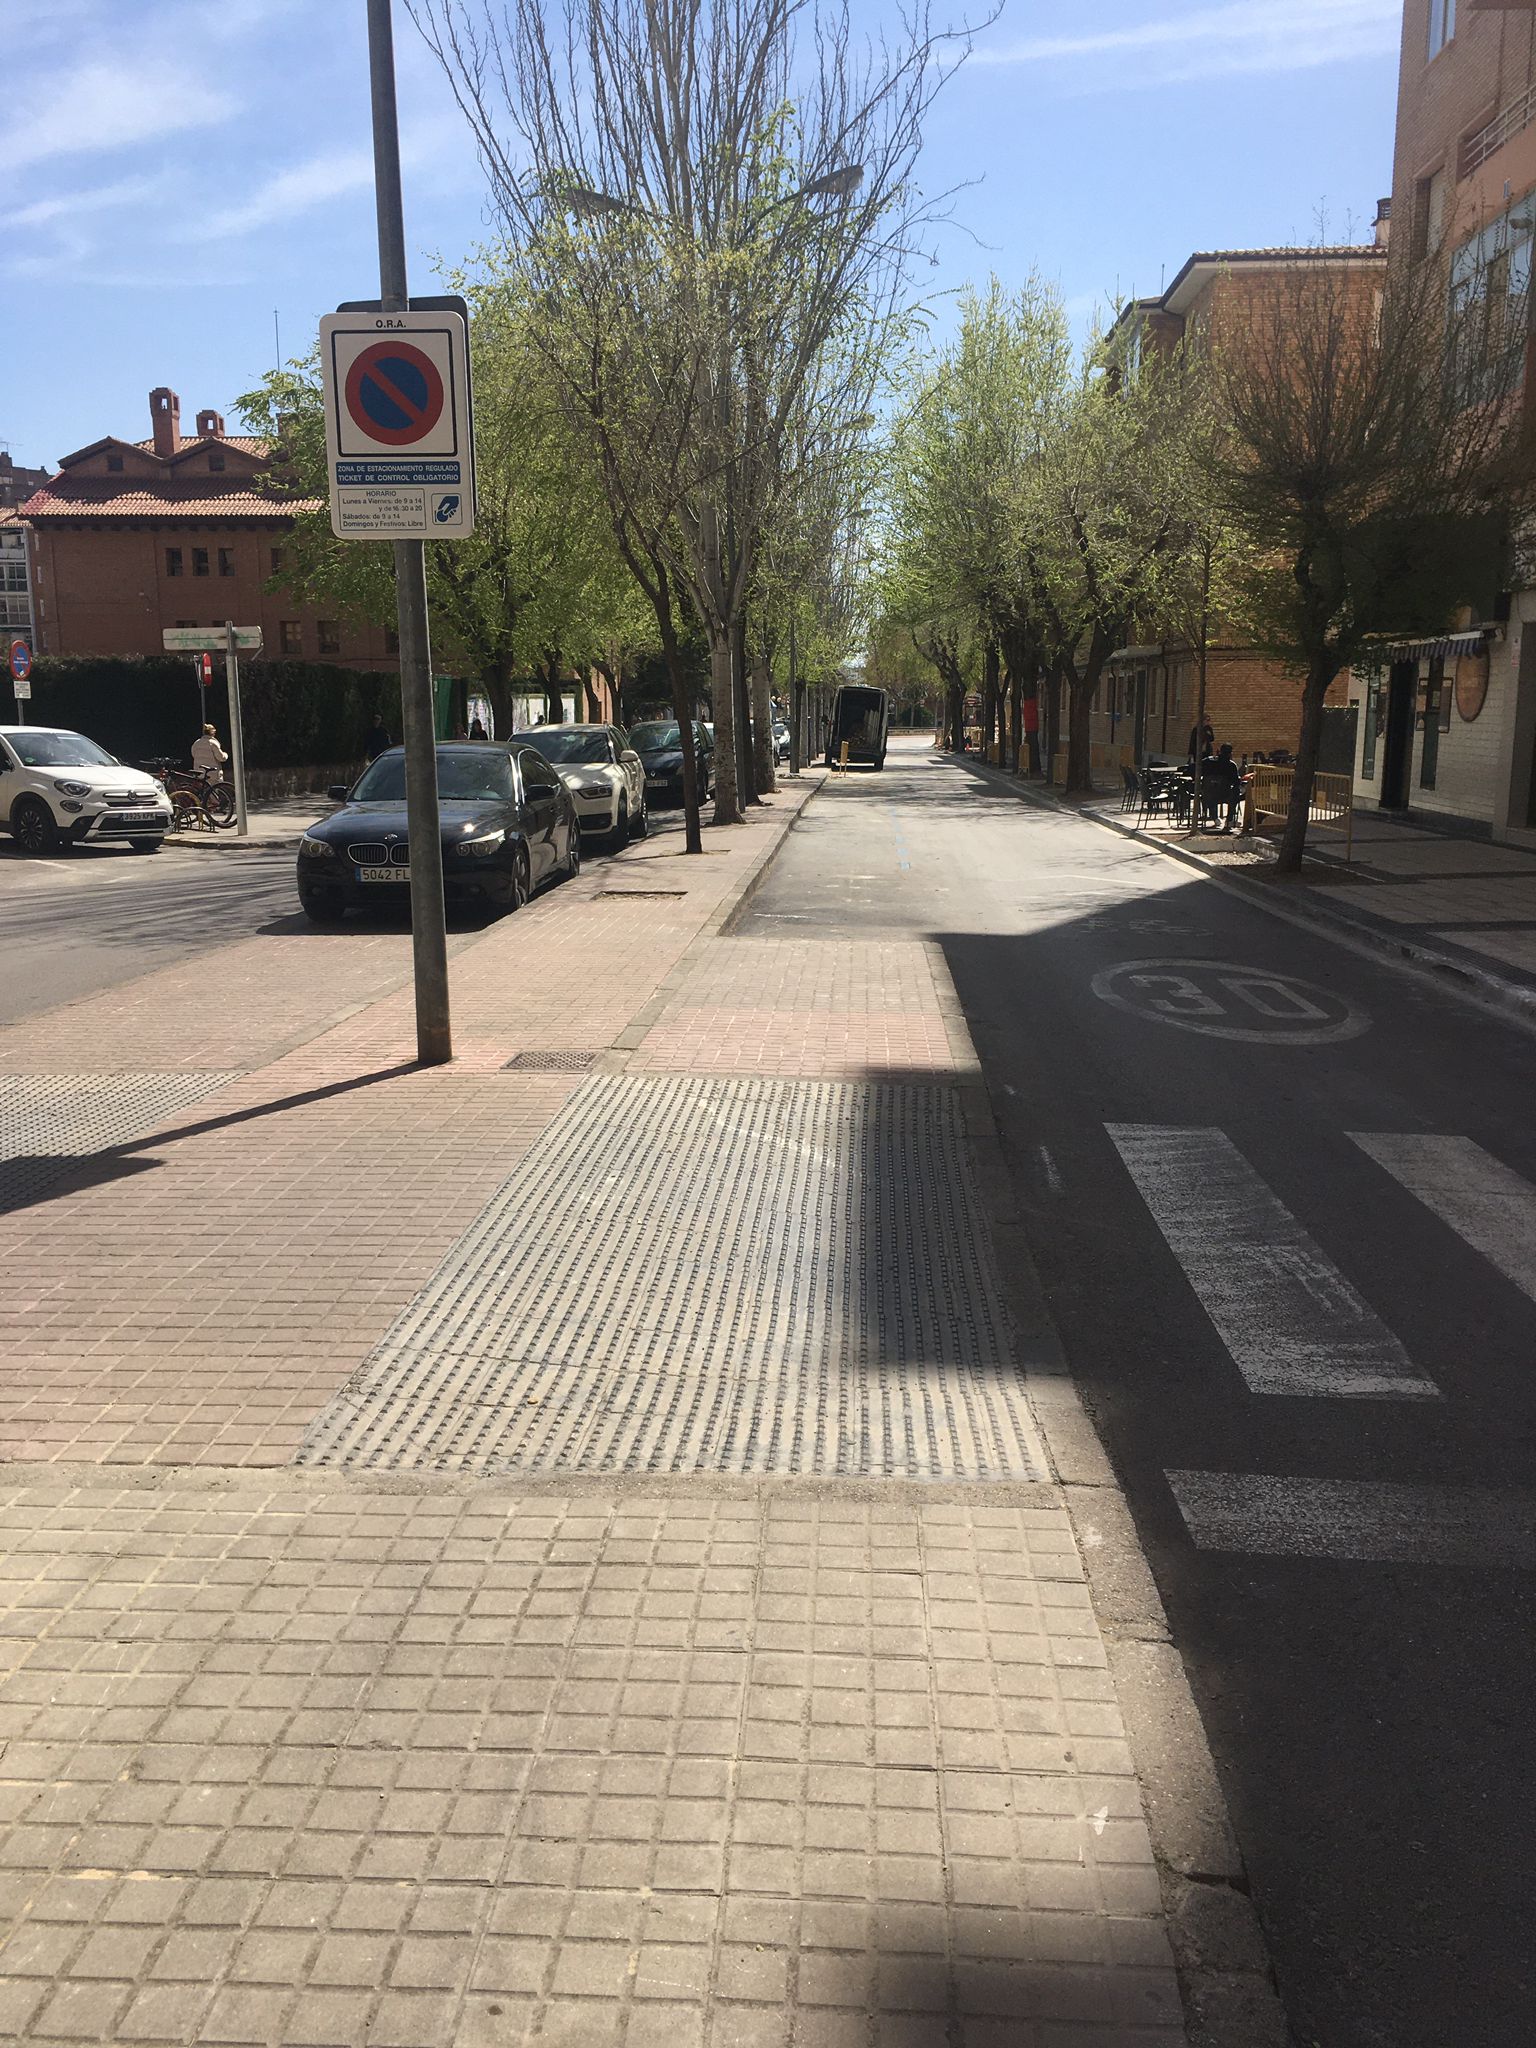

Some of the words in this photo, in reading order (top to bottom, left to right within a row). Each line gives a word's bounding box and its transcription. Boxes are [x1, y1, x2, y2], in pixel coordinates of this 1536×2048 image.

[376, 320, 406, 328] O.R.A.
[362, 869, 392, 880] 5042
[395, 869, 410, 880] FL
[1129, 974, 1330, 1020] 30
